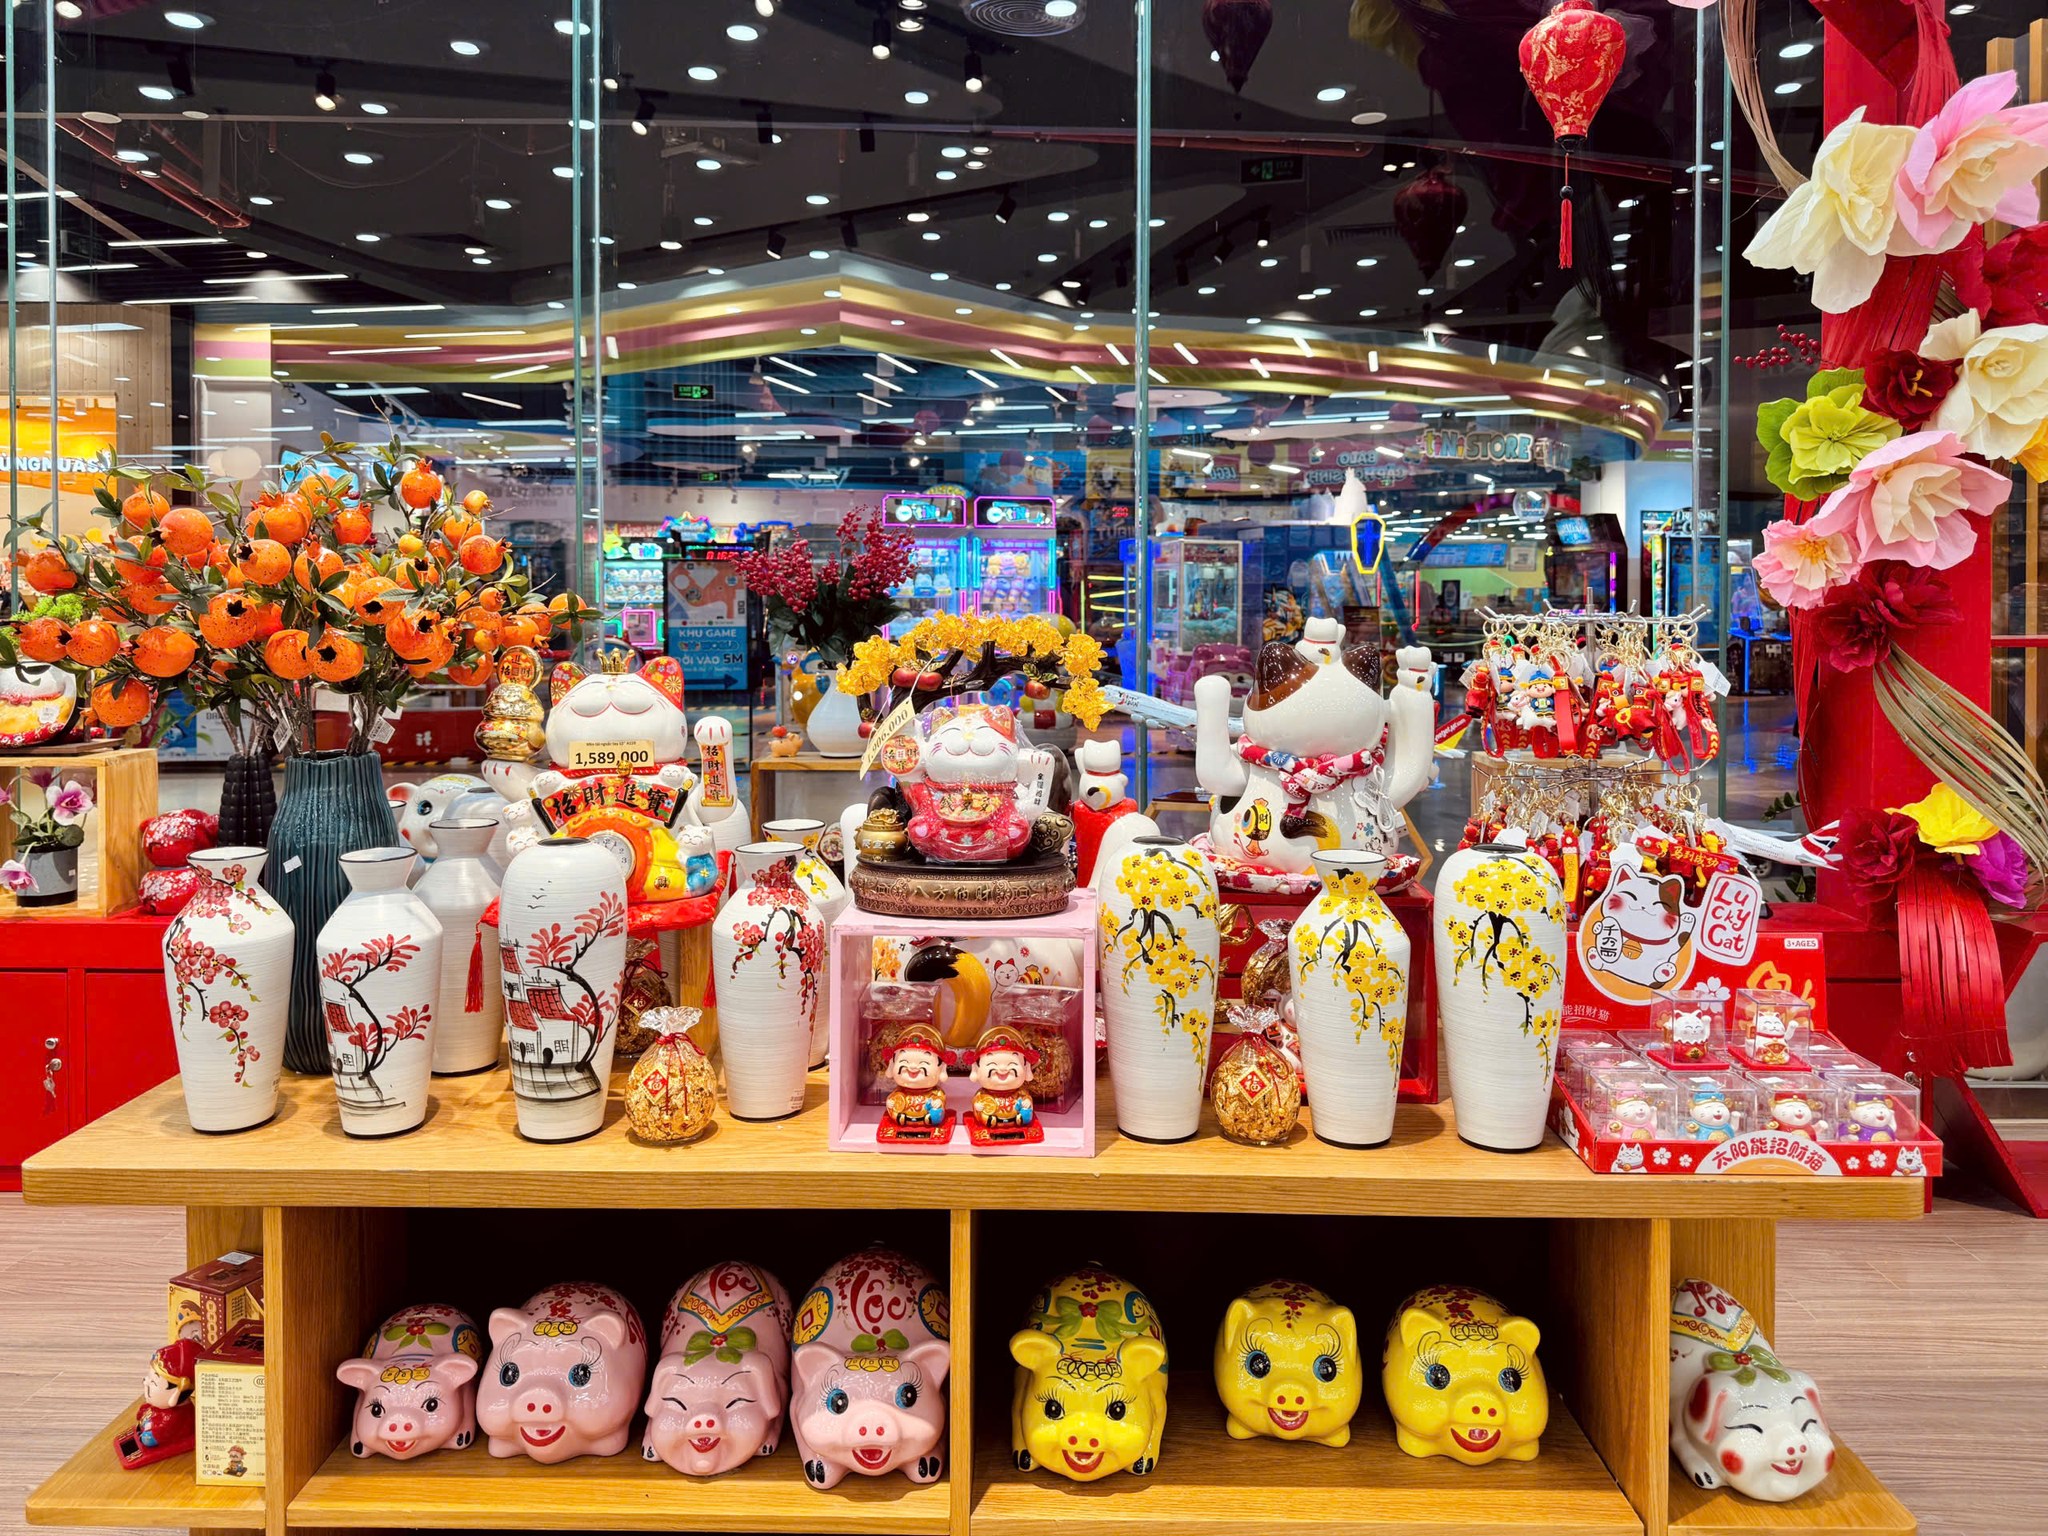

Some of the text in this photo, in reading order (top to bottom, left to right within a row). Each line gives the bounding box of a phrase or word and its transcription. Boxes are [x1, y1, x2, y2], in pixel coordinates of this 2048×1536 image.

[1466, 432, 1533, 462] STORE
[679, 629, 737, 637] KHU GAME
[723, 653, 743, 664] 5M
[575, 750, 649, 768] 1,589,000
[1670, 845, 1719, 868] 马到成功
[1708, 924, 1744, 952] Cat
[1244, 1074, 1261, 1092] 福
